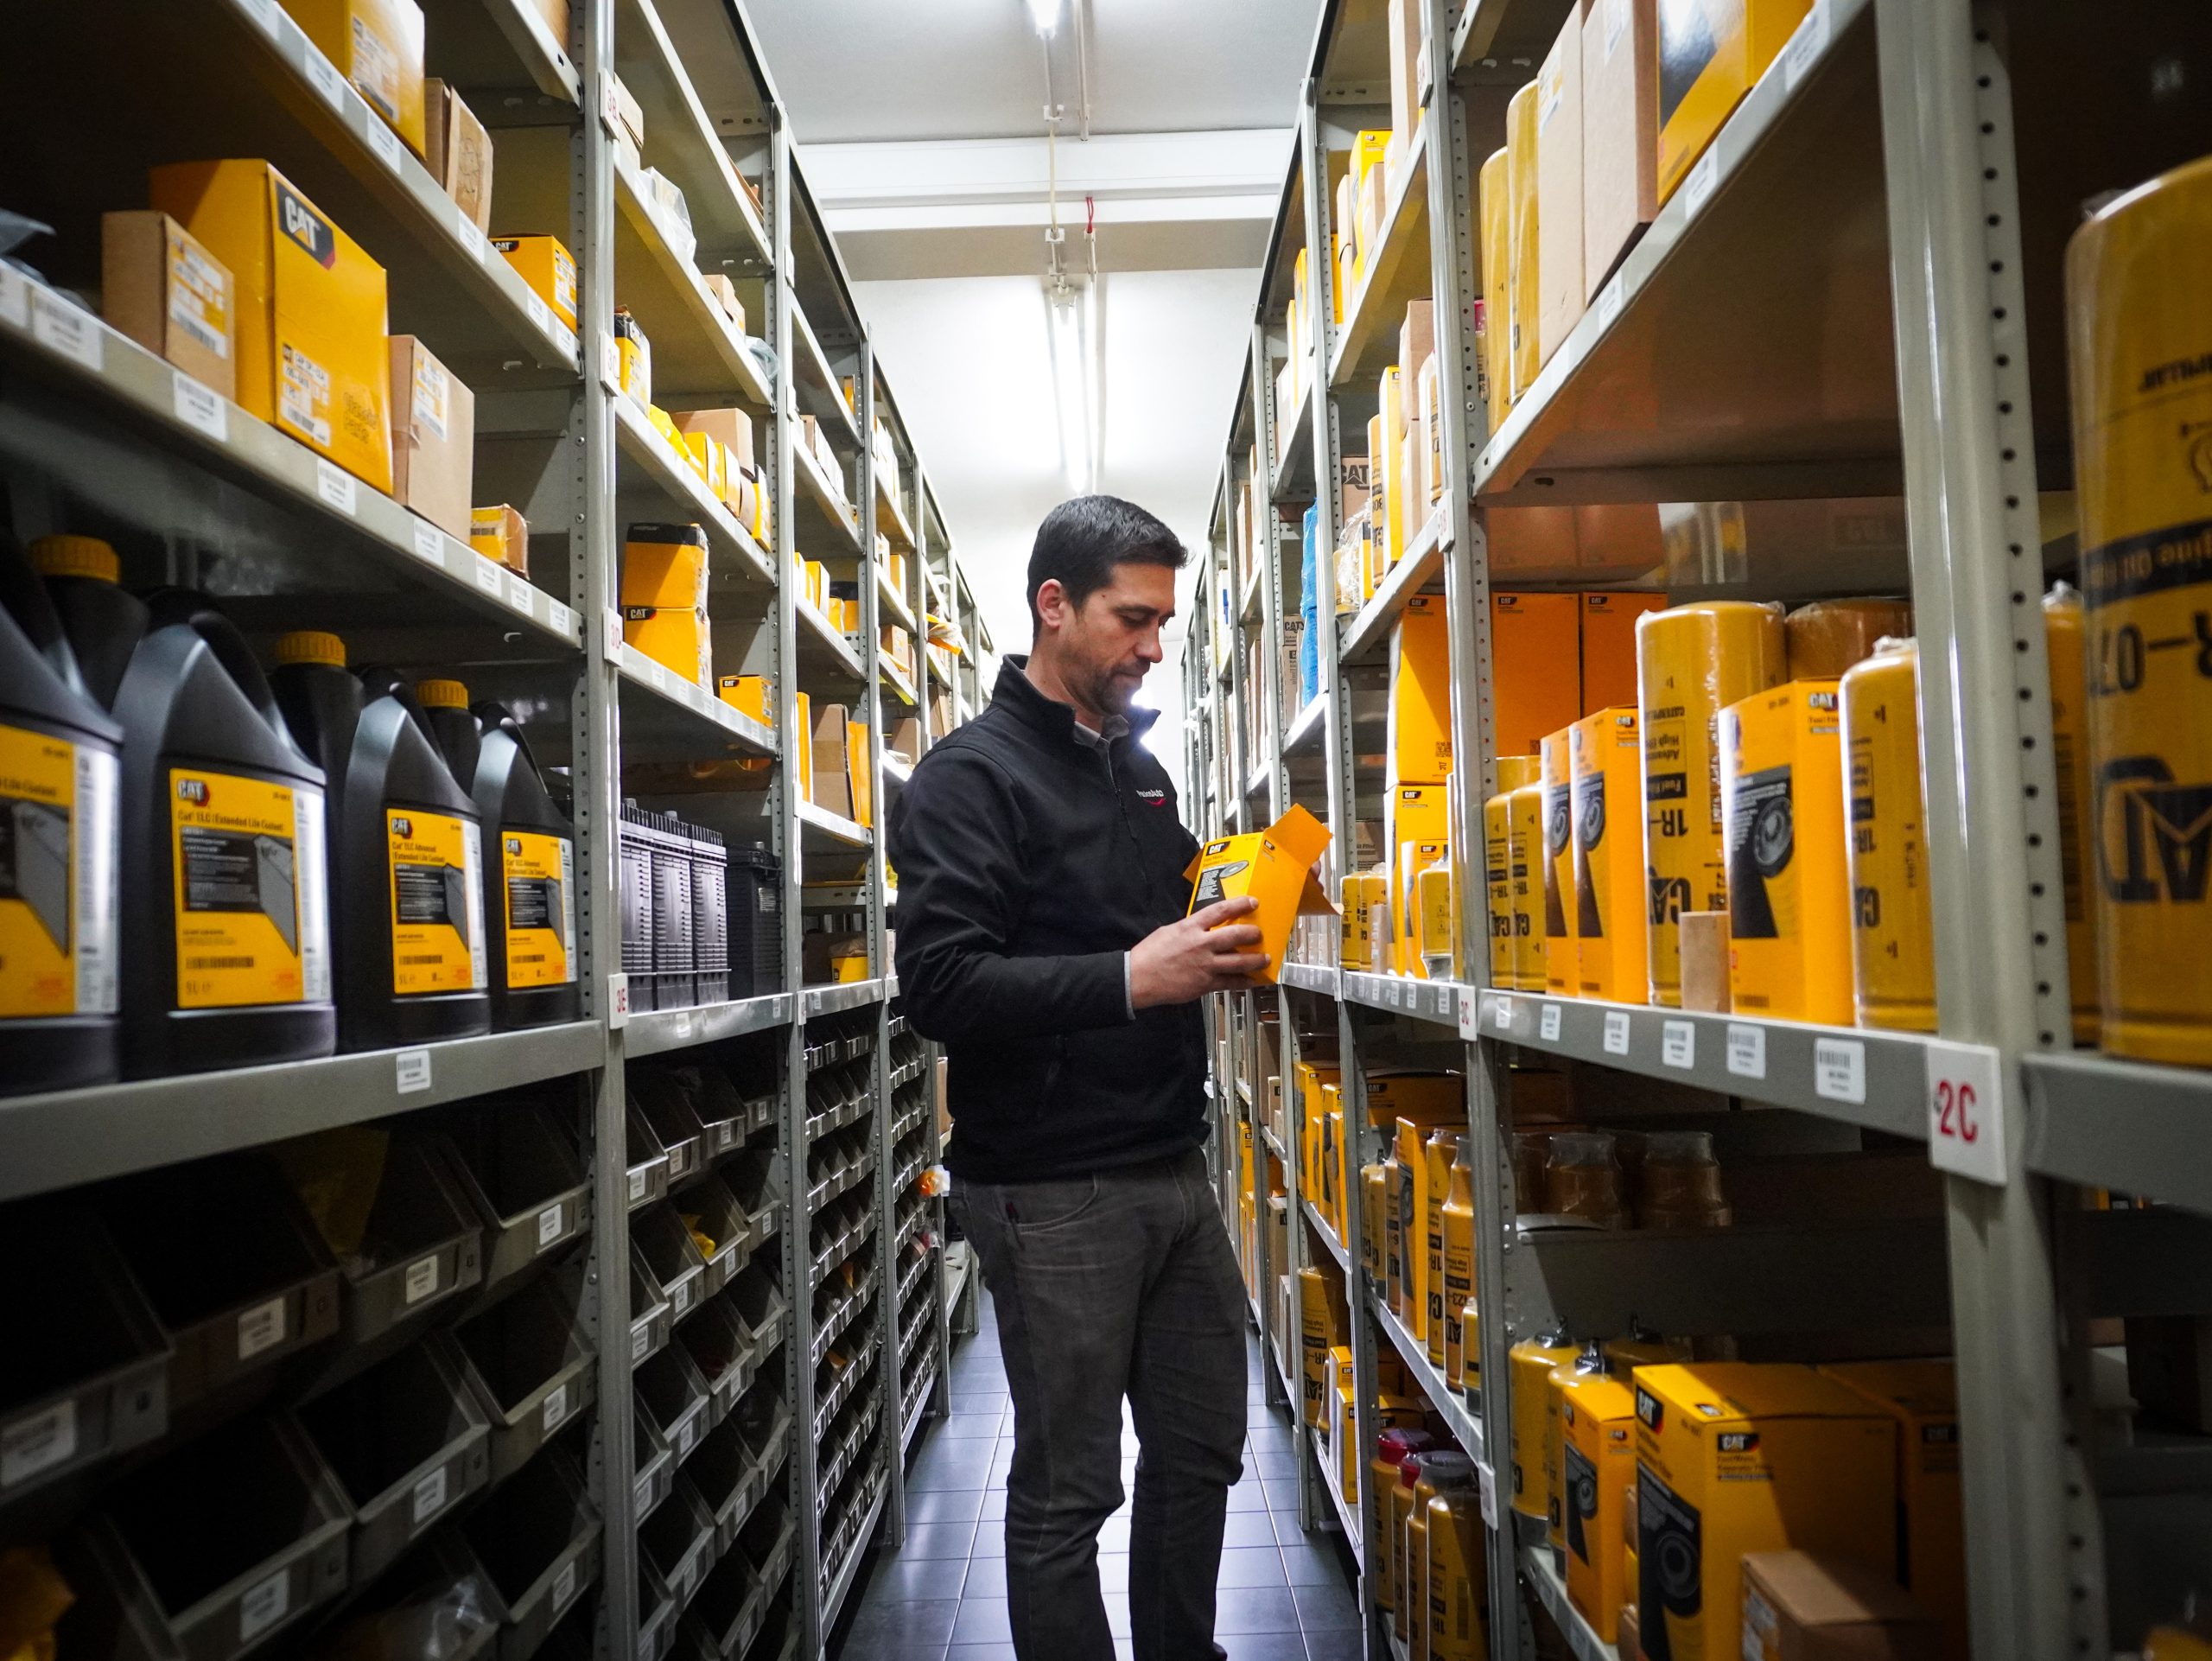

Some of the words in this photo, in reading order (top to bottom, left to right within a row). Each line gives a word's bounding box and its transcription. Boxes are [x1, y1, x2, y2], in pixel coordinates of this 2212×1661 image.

[285, 195, 317, 251] CAT
[495, 241, 511, 251] CAT
[630, 608, 646, 620] CAT
[1809, 693, 1834, 707] CAT
[178, 780, 205, 802] CAT
[391, 818, 409, 835] CAT
[1647, 809, 1689, 837] 1R-
[2101, 769, 2212, 903] AT
[1208, 843, 1225, 855] CAT
[1648, 875, 1691, 924] CA
[1491, 914, 1511, 938] CA
[1938, 1079, 1978, 1143] 2C
[1637, 1388, 1657, 1426] CAT
[1721, 1435, 1746, 1451] CAT
